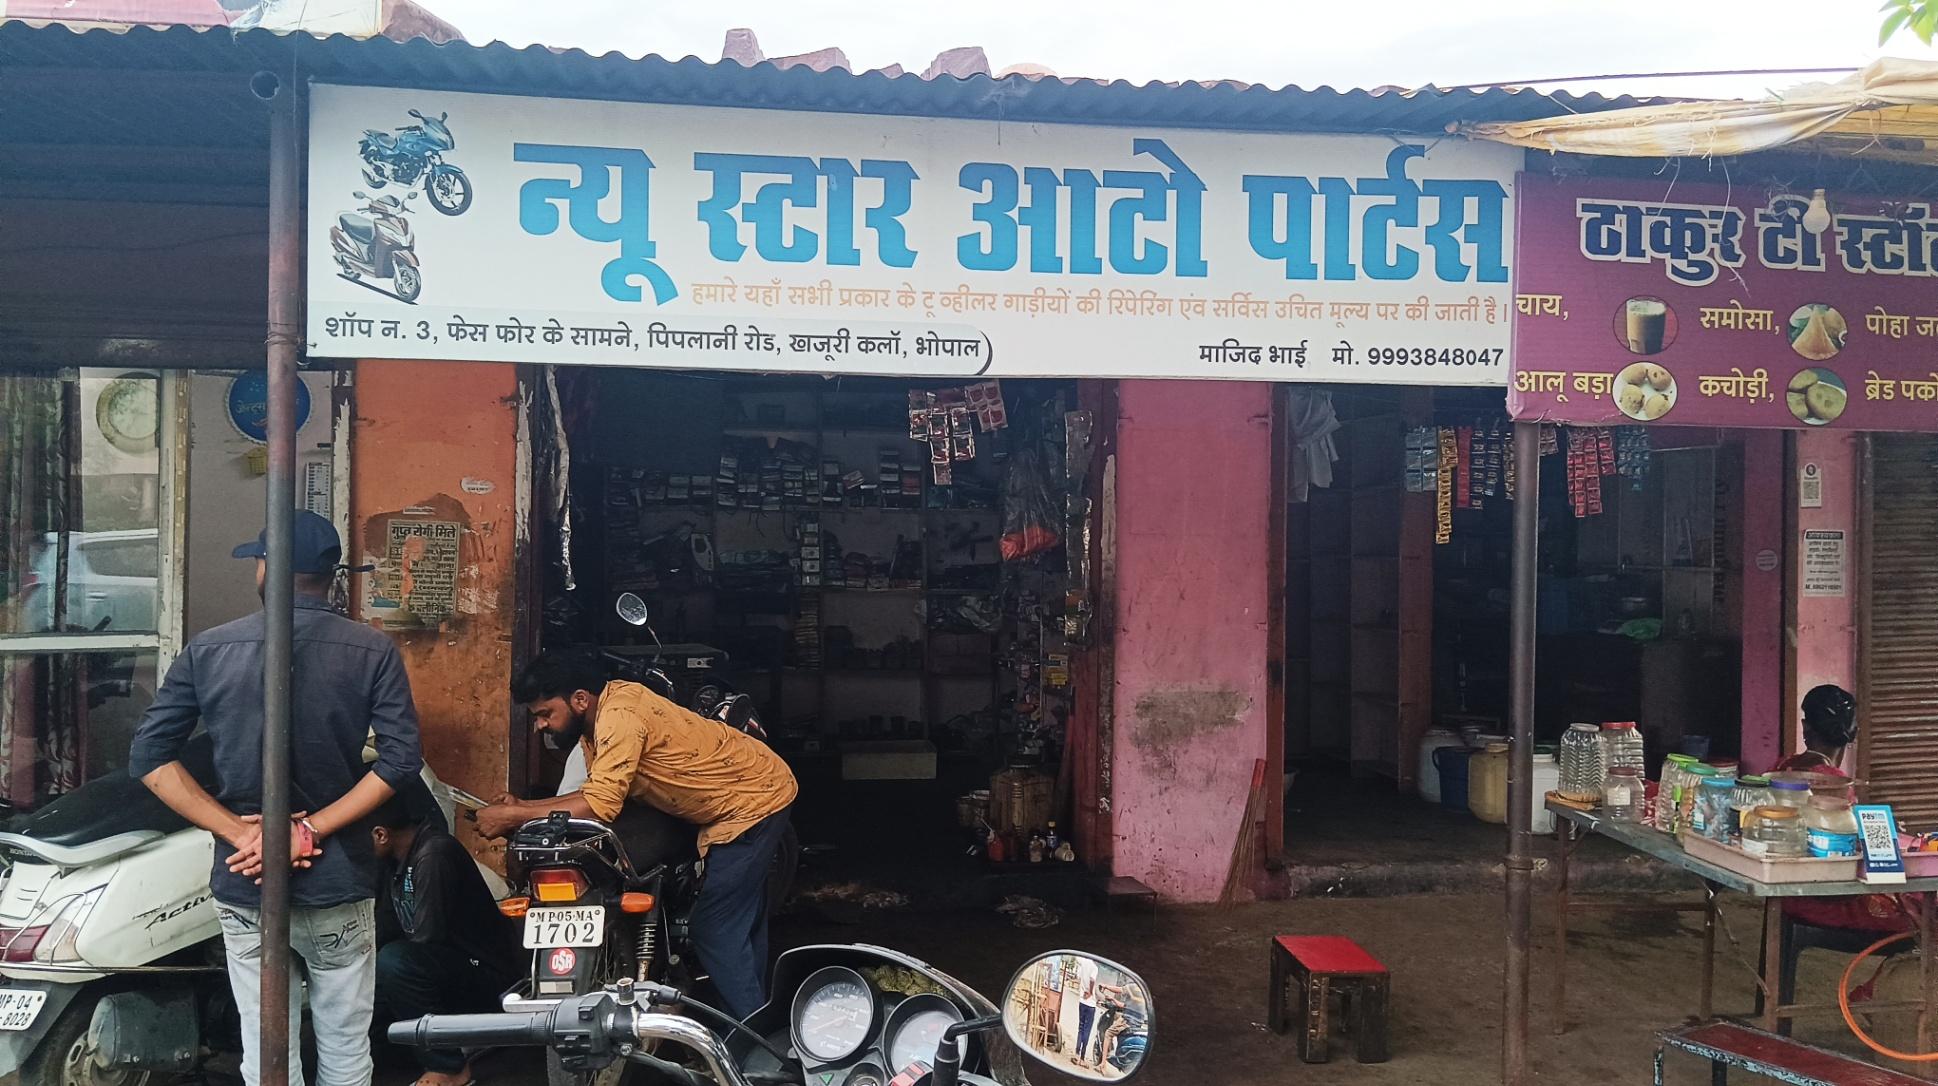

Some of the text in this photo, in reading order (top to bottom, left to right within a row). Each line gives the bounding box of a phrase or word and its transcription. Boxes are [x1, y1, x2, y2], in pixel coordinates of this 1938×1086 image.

[514, 138, 1509, 305] न्यू स्टार आटो पार्टस
[1576, 194, 1938, 287] ठाकुर टी स्टॉ
[691, 276, 738, 305] हमारे
[744, 277, 782, 307] यहाँ
[788, 279, 833, 306] सभी
[839, 287, 890, 308] प्रकार
[896, 282, 916, 309] के
[922, 290, 936, 318] टू
[939, 283, 997, 313] व्हीलर
[1076, 288, 1102, 315] की
[1213, 291, 1269, 319] सर्विस
[1275, 293, 1324, 320] उचित
[1329, 300, 1370, 328] मूल्य
[1376, 302, 1399, 322] पर
[1405, 295, 1430, 321] की
[1435, 295, 1481, 322] जाती
[1699, 300, 1780, 335] समोसा,
[325, 312, 374, 338] शॉप
[447, 315, 489, 343] फेस
[496, 317, 536, 345] फोर
[543, 319, 564, 345] के
[571, 321, 639, 350] सामने,
[648, 322, 738, 352] पिपलानी
[744, 326, 781, 355] रोड,
[789, 328, 850, 361] खजूरी
[916, 331, 981, 357] भोपाल
[1865, 306, 1910, 338] पोहा
[1199, 338, 1262, 364] माजिद
[1269, 339, 1308, 368] भाई
[1367, 347, 1504, 367] 9993848047
[1514, 370, 1614, 403] आलू बड़ा
[1865, 370, 1895, 400] ब्रेड
[145, 893, 214, 930] Activ
[533, 922, 595, 944] 1702
